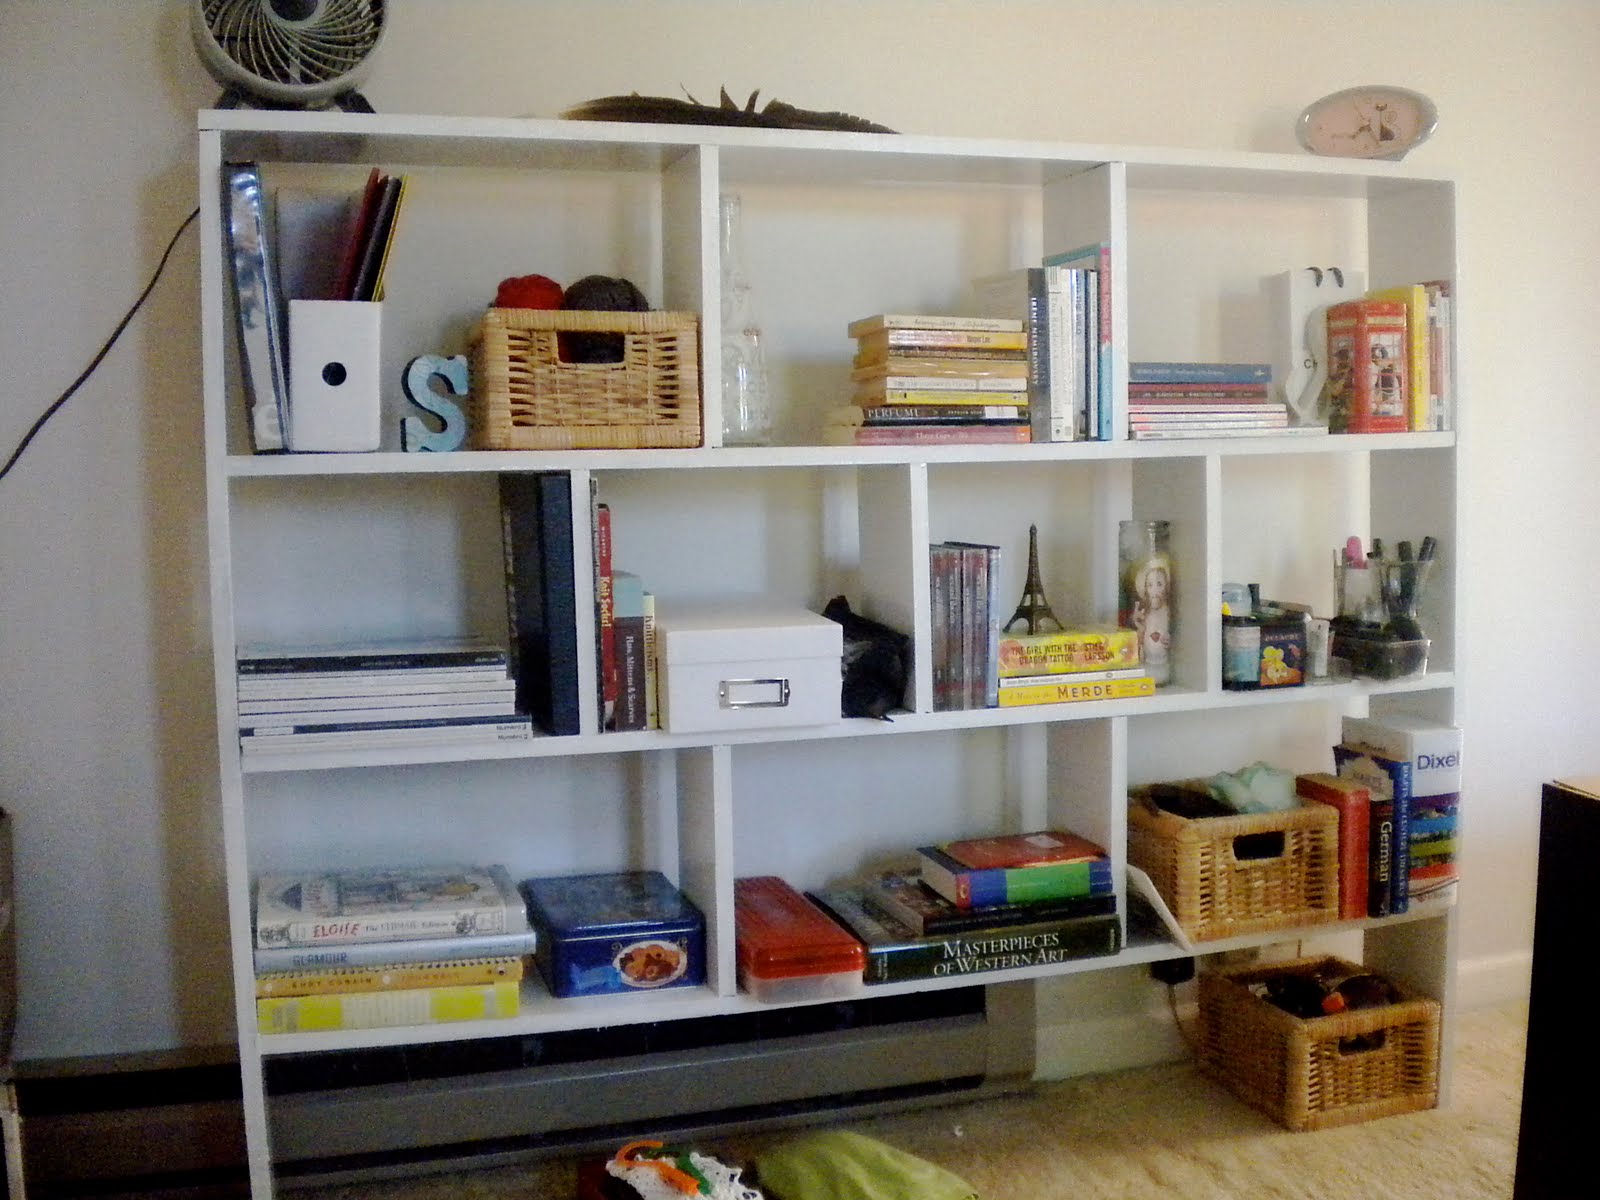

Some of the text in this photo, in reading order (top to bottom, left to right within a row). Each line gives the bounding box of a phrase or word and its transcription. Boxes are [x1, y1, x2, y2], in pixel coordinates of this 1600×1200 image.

[401, 354, 469, 453] S
[600, 576, 610, 597] Knit
[1019, 653, 1075, 665] DRAGON TATTOO
[1026, 645, 1043, 655] GIRL
[1044, 644, 1062, 653] WITH
[1064, 643, 1077, 653] THE
[626, 656, 635, 686] Mittens
[1057, 684, 1113, 699] MERDE
[627, 694, 636, 723] Scarves
[1379, 821, 1392, 882] German
[313, 922, 361, 938] ELOISE
[943, 932, 1060, 959] MASTERPIECES
[293, 952, 348, 966] GLAMOUR
[933, 947, 1069, 977] OF WESTERN ART
